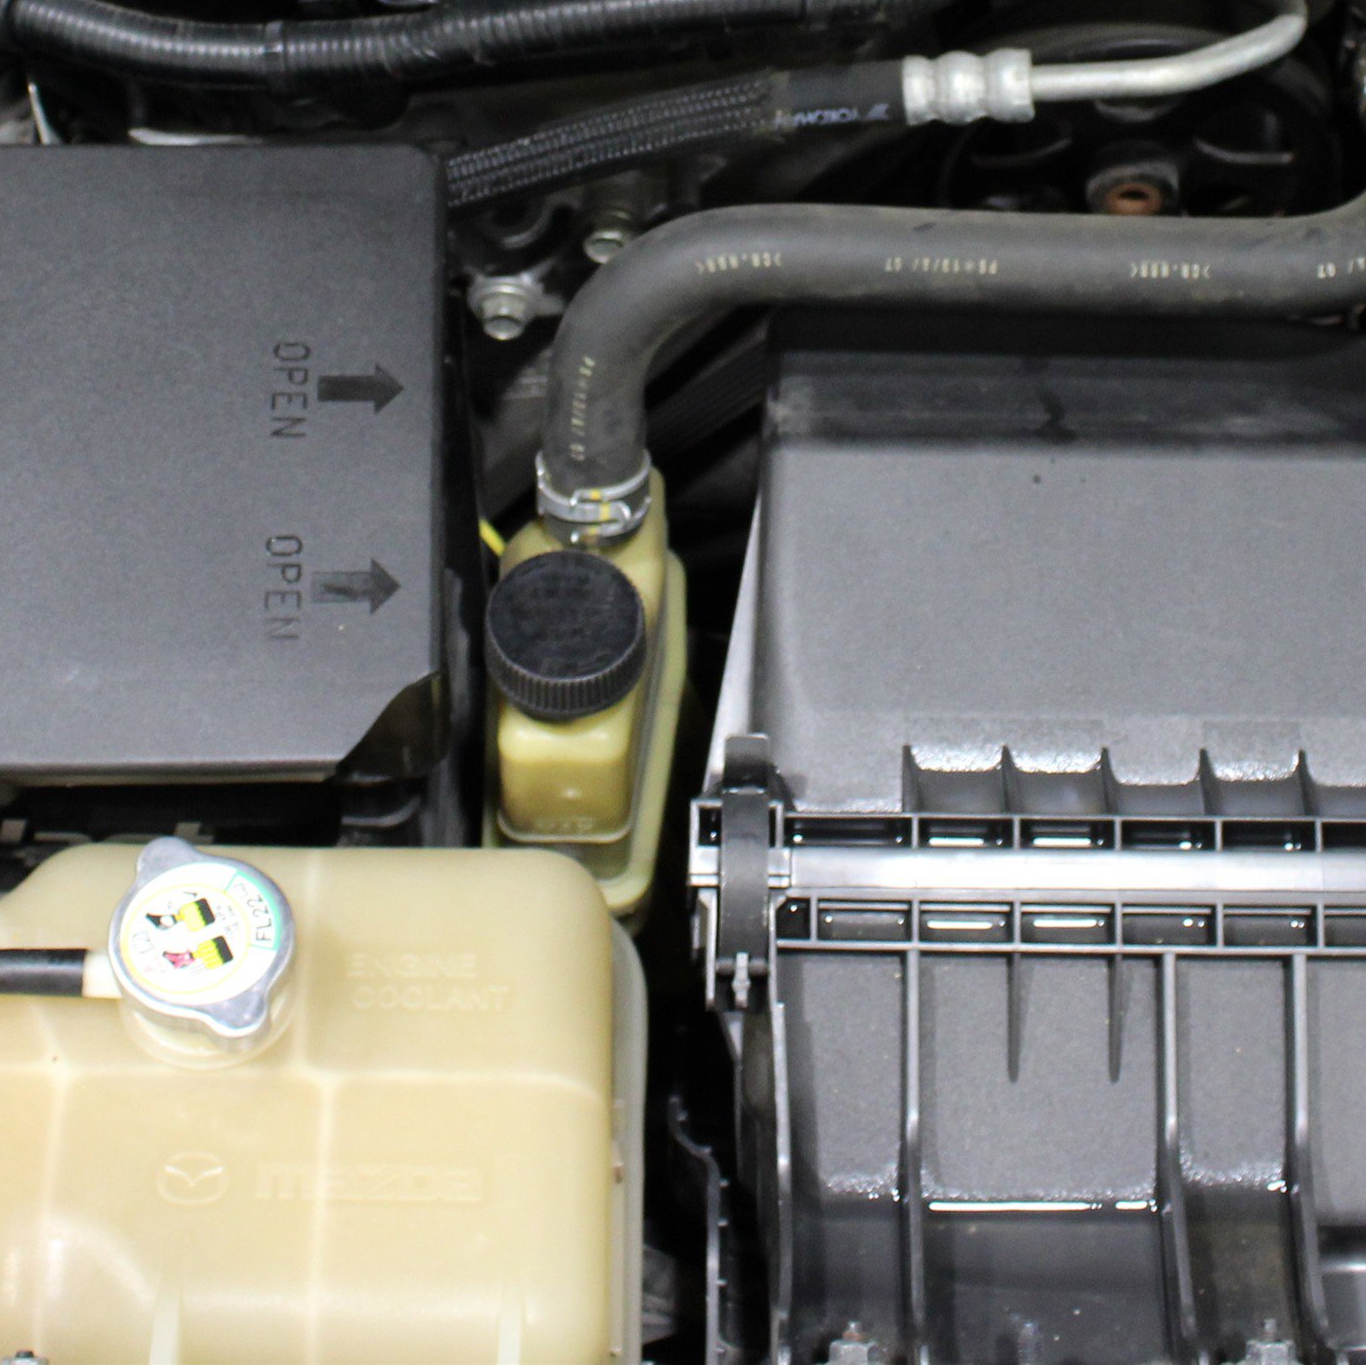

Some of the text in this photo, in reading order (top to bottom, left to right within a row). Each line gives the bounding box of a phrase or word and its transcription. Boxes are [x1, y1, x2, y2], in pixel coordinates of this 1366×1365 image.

[271, 342, 311, 438] OPEN
[264, 534, 303, 641] OPEN
[246, 894, 272, 941] FL22
[345, 952, 477, 978] ENGINE
[353, 984, 509, 1012] COOLANT
